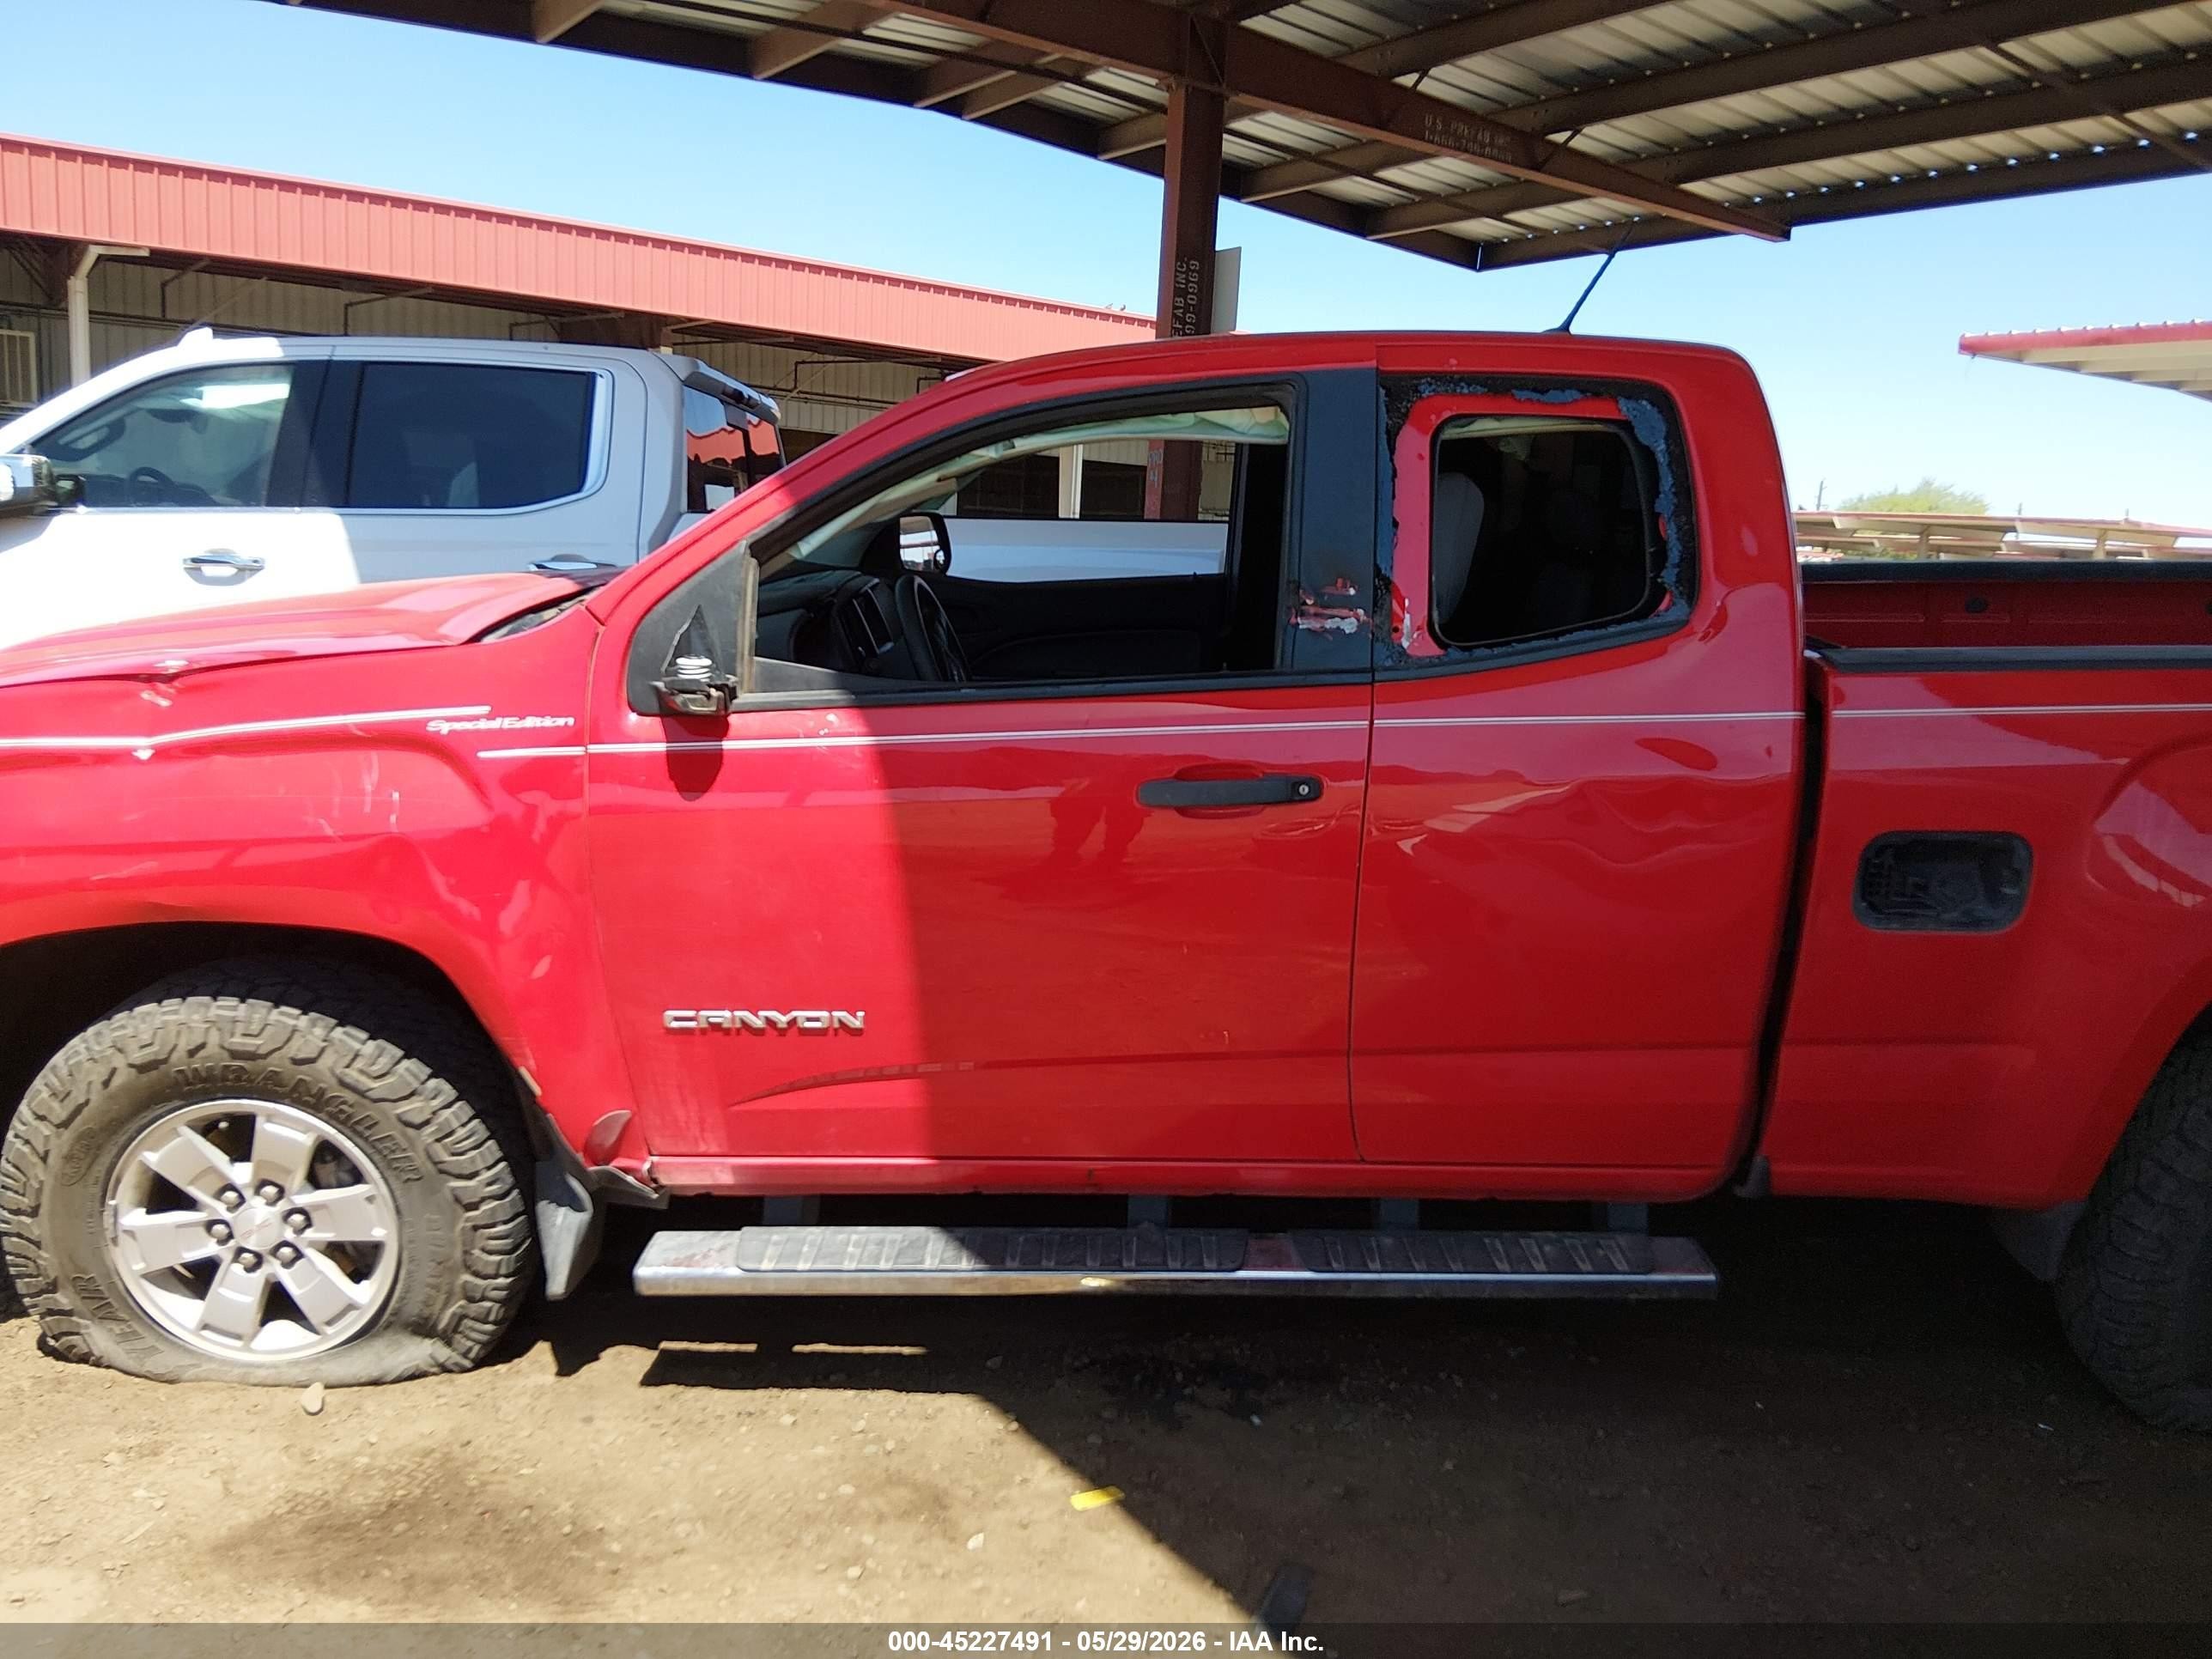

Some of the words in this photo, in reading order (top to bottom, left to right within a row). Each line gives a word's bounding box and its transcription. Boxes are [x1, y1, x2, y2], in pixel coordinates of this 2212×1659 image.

[1175, 257, 1188, 289] INC.
[425, 716, 501, 736] Special
[501, 715, 576, 730] Edition
[663, 1010, 866, 1030] CANYON
[172, 1061, 424, 1184] WRANGLER
